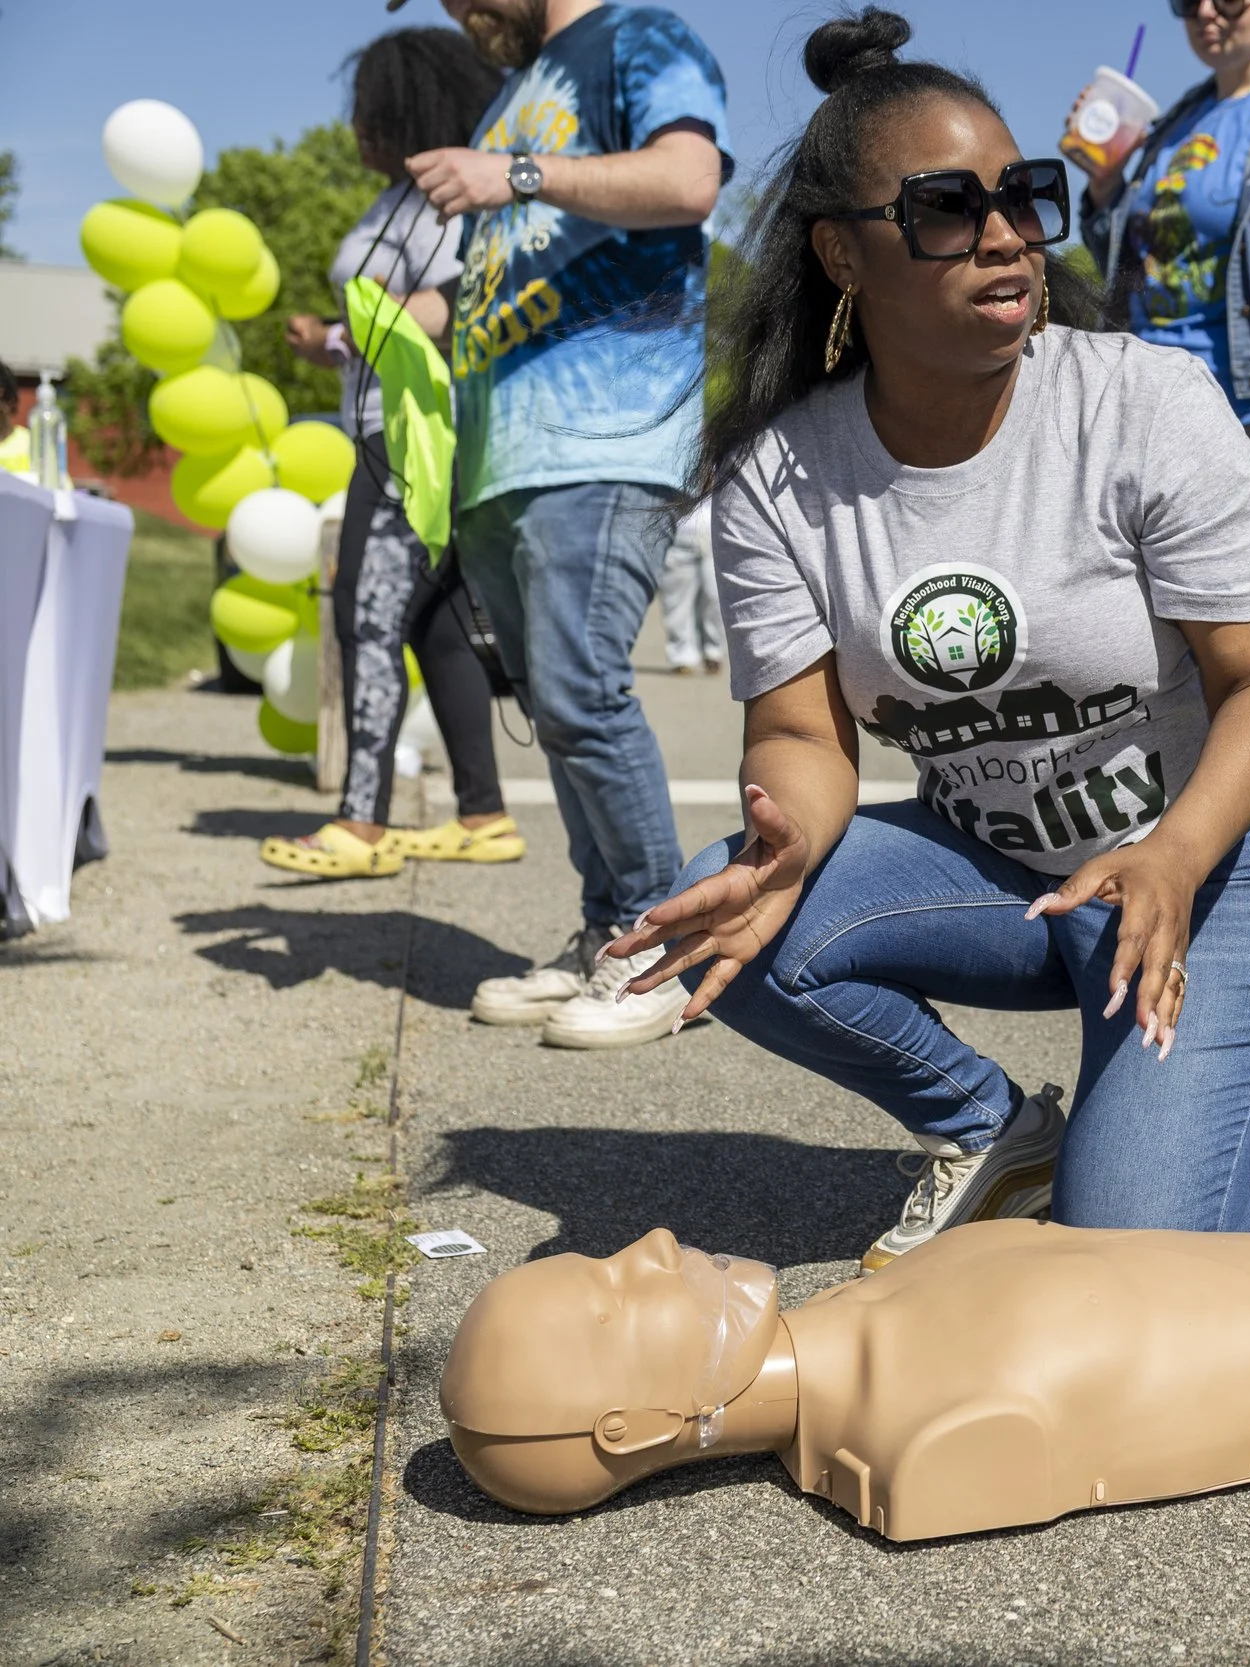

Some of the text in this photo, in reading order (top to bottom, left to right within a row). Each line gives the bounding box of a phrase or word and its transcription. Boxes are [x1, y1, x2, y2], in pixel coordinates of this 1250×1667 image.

[893, 576, 1010, 627] Neighborhood Vitality Corp.
